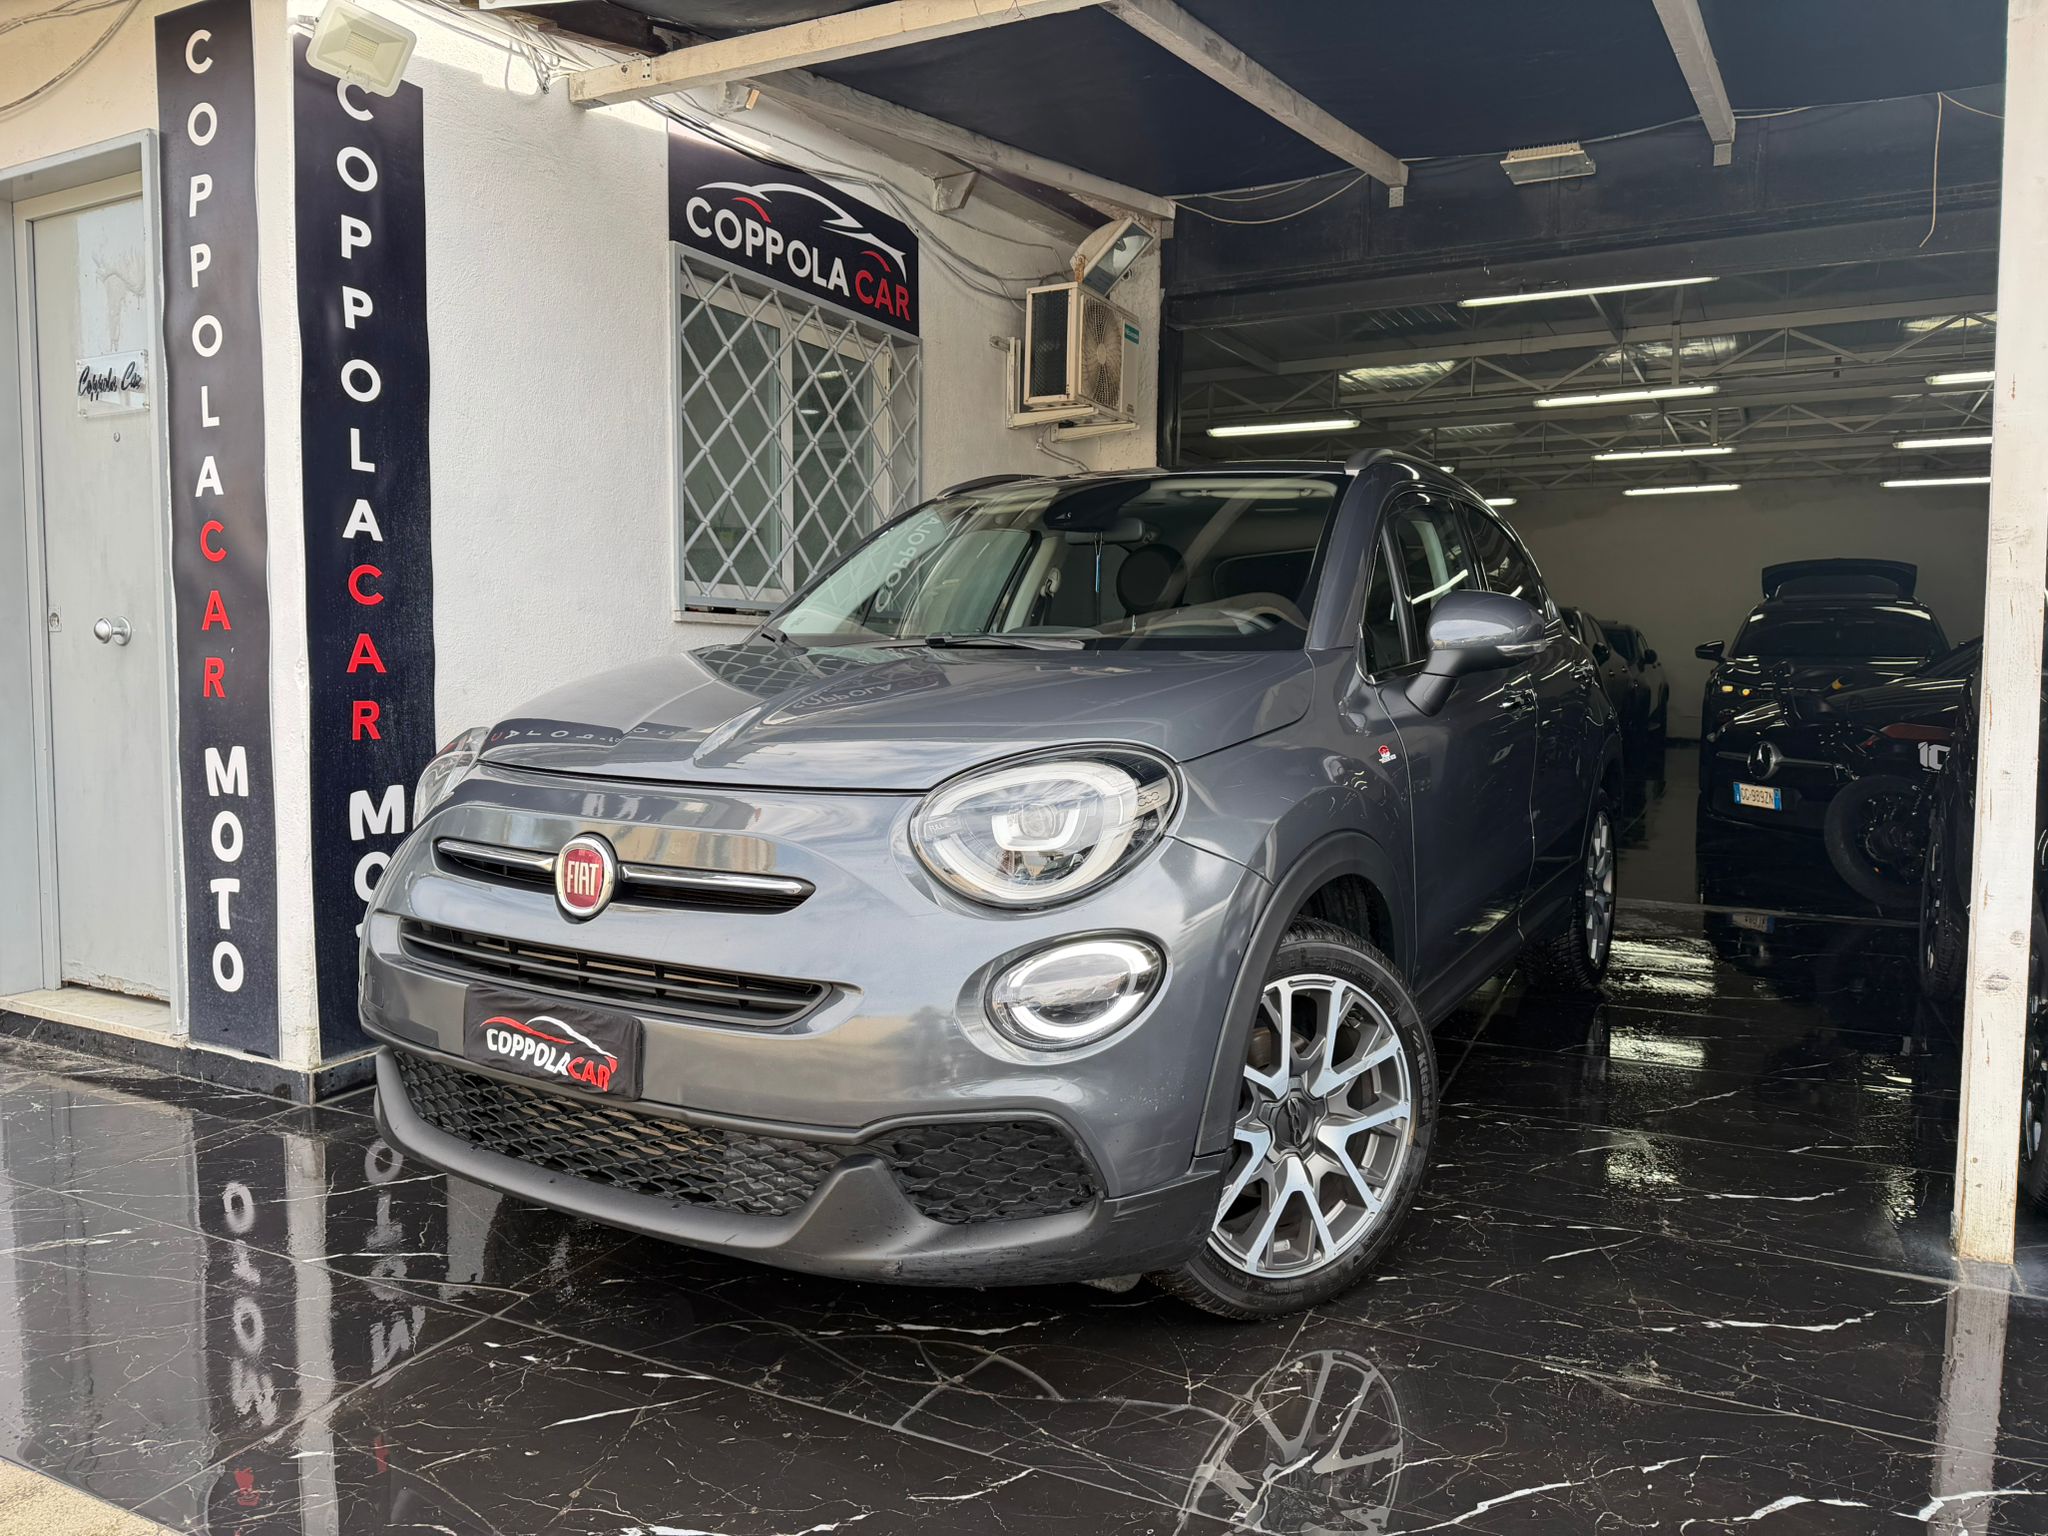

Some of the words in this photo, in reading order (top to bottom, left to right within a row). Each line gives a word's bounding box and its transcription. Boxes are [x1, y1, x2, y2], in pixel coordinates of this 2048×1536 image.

[78, 365, 117, 402] Coppola
[204, 745, 249, 993] MOTO
[566, 860, 600, 896] FIAT
